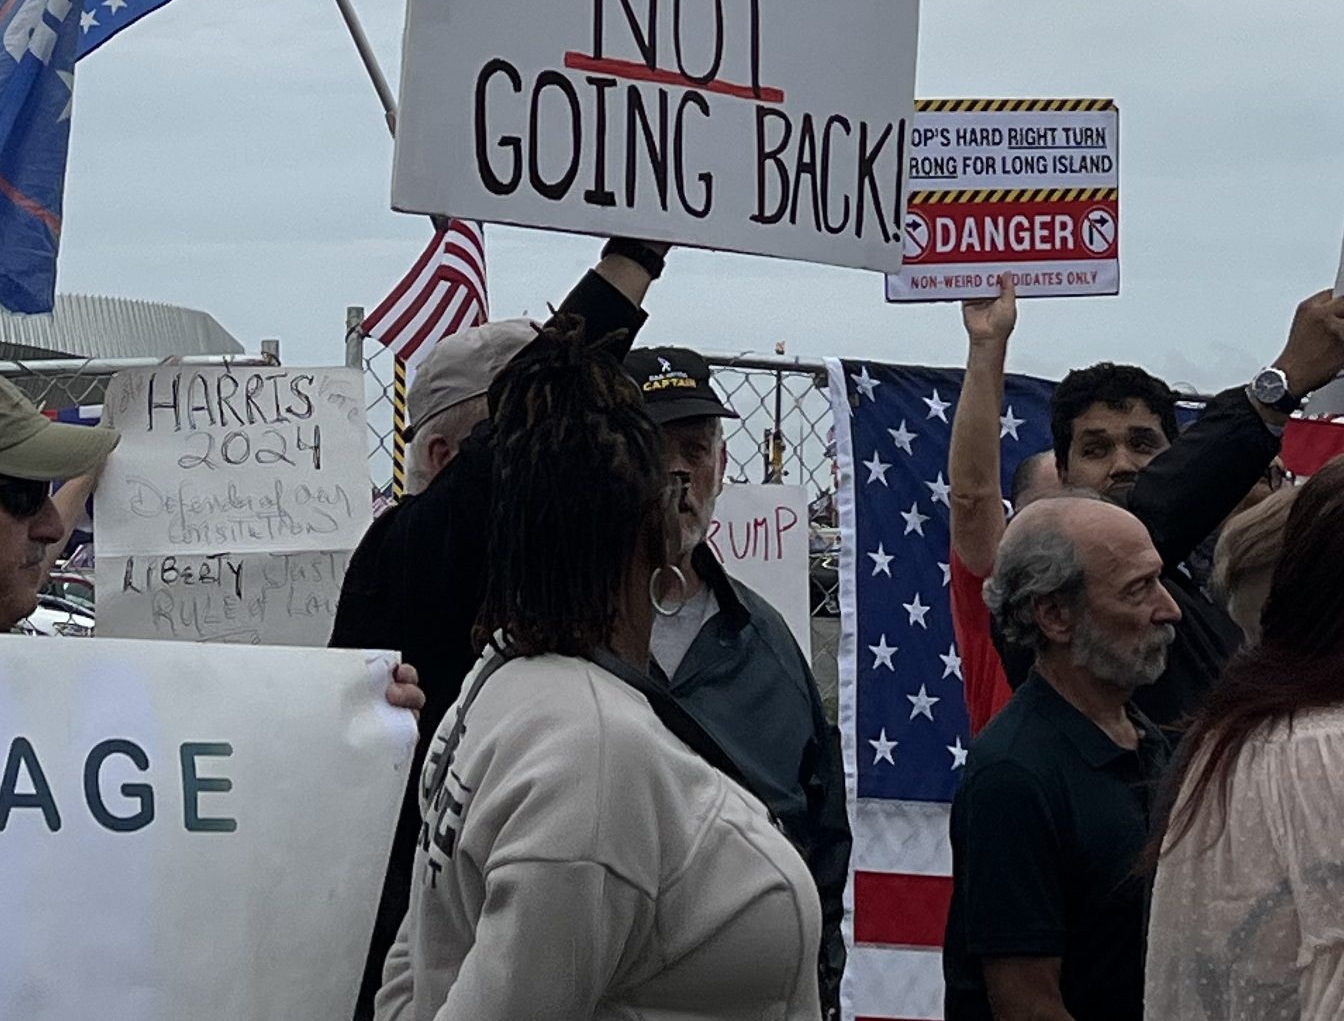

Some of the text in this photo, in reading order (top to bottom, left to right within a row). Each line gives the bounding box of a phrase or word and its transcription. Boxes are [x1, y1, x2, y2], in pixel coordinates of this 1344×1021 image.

[474, 58, 906, 243] GOING BACK!
[911, 126, 1106, 148] OP'S HARD RIGHT TURN
[909, 154, 1113, 176] RONG FOR LONG ISLAND
[935, 214, 1074, 254] DANGER
[911, 270, 1098, 290] NON-WEIRD CADIDATES ONLY
[147, 372, 315, 431] HARRIS
[177, 425, 321, 471] 2024
